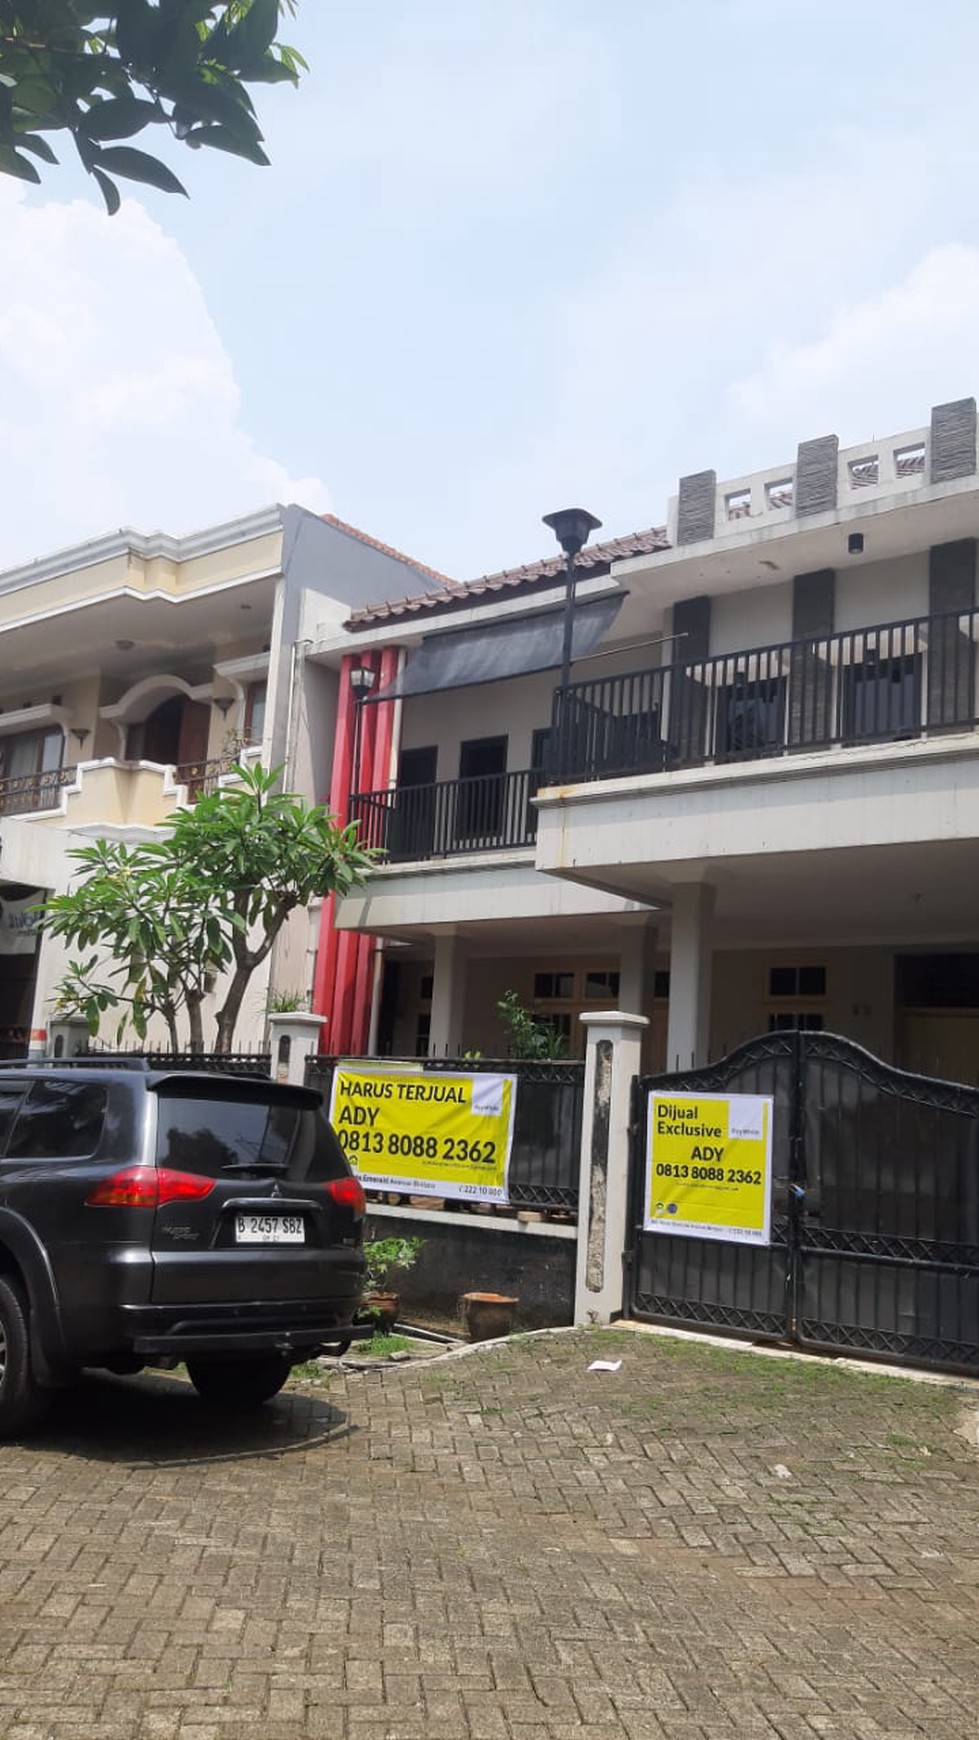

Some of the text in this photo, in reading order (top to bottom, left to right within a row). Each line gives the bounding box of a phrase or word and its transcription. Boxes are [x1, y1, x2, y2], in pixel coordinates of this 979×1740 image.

[340, 1081, 466, 1103] HARUS TERJUAL
[338, 1105, 380, 1127] ADY
[657, 1104, 699, 1121] Dijual
[657, 1120, 723, 1138] Exclusive
[338, 1129, 496, 1164] 0813 8088 2362
[690, 1145, 725, 1162] ADY
[655, 1163, 762, 1185] 0813 8088 2362
[238, 1217, 303, 1234] B 2457 SBZ
